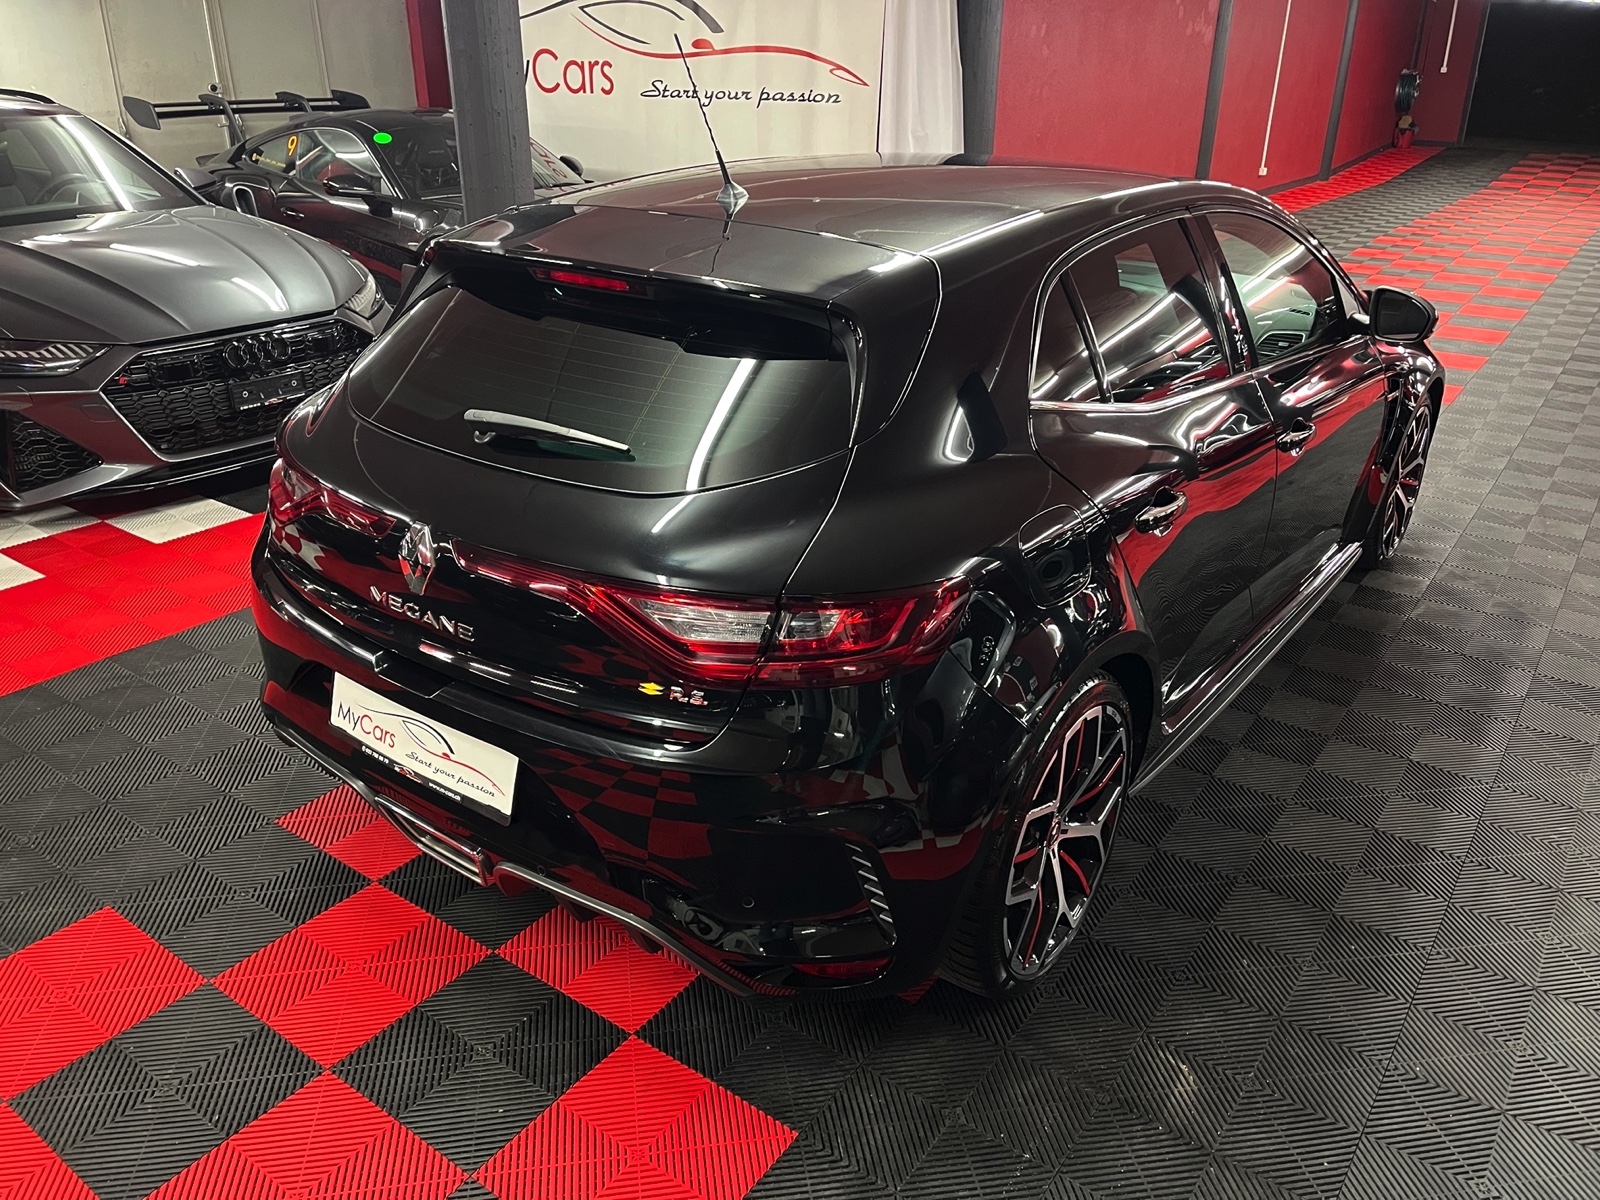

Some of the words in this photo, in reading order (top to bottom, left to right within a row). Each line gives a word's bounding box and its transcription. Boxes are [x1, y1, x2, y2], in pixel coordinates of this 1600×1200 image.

[640, 79, 698, 99] Start
[702, 89, 753, 107] your
[756, 86, 842, 109] passion
[287, 134, 299, 157] 9
[370, 586, 475, 642] MEGANE
[337, 701, 396, 749] MyCars
[405, 751, 433, 769] Start
[432, 765, 456, 780] your
[456, 775, 496, 798] passion
